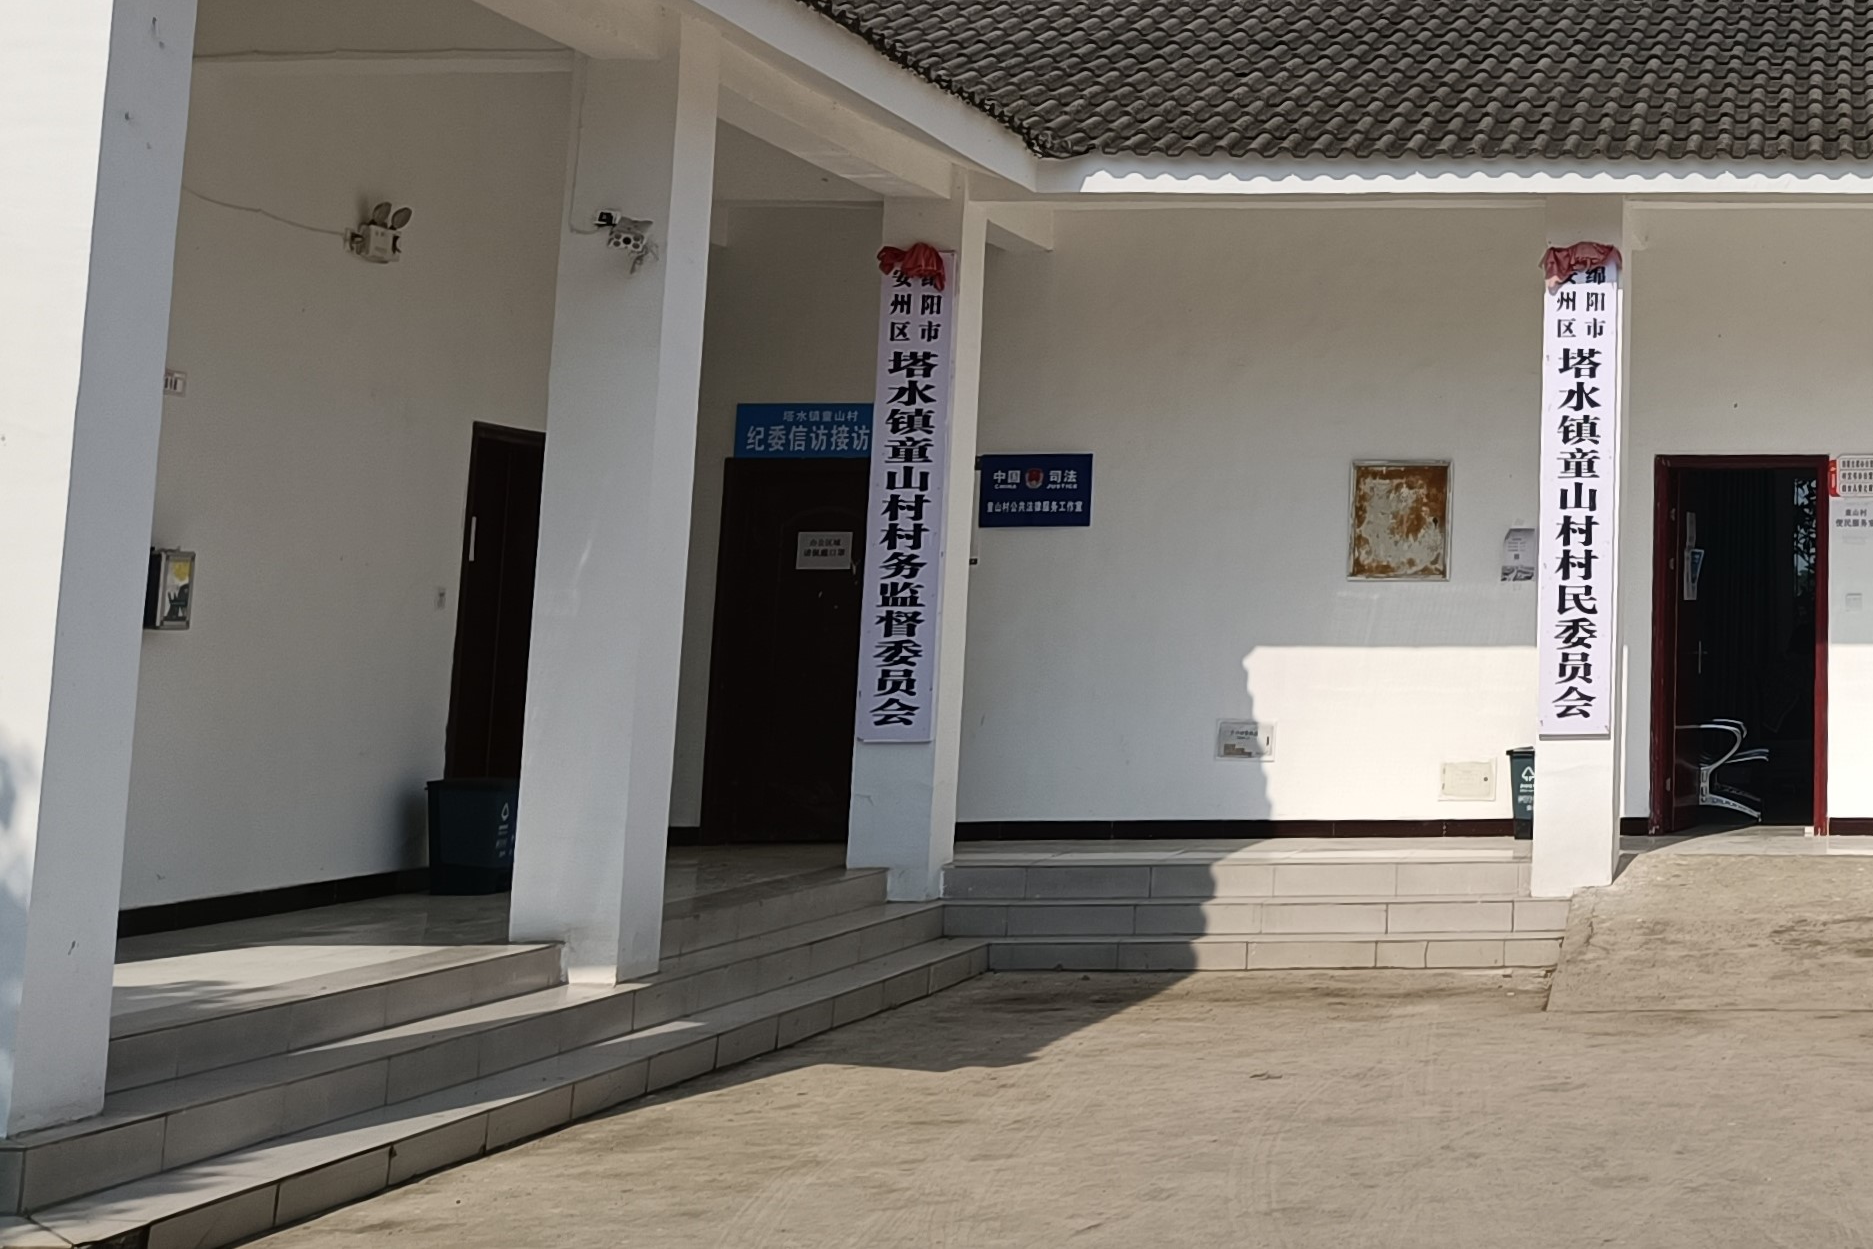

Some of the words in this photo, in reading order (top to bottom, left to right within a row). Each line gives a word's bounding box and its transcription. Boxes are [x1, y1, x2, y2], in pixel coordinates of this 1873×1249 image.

[783, 410, 859, 422] 塔水镇童山村
[993, 470, 1021, 484] 中国
[1049, 470, 1078, 484] 司法
[868, 349, 938, 727] 塔水镇童山村村务监督委员会
[1551, 348, 1602, 720] 塔水镇童山村村民委员会
